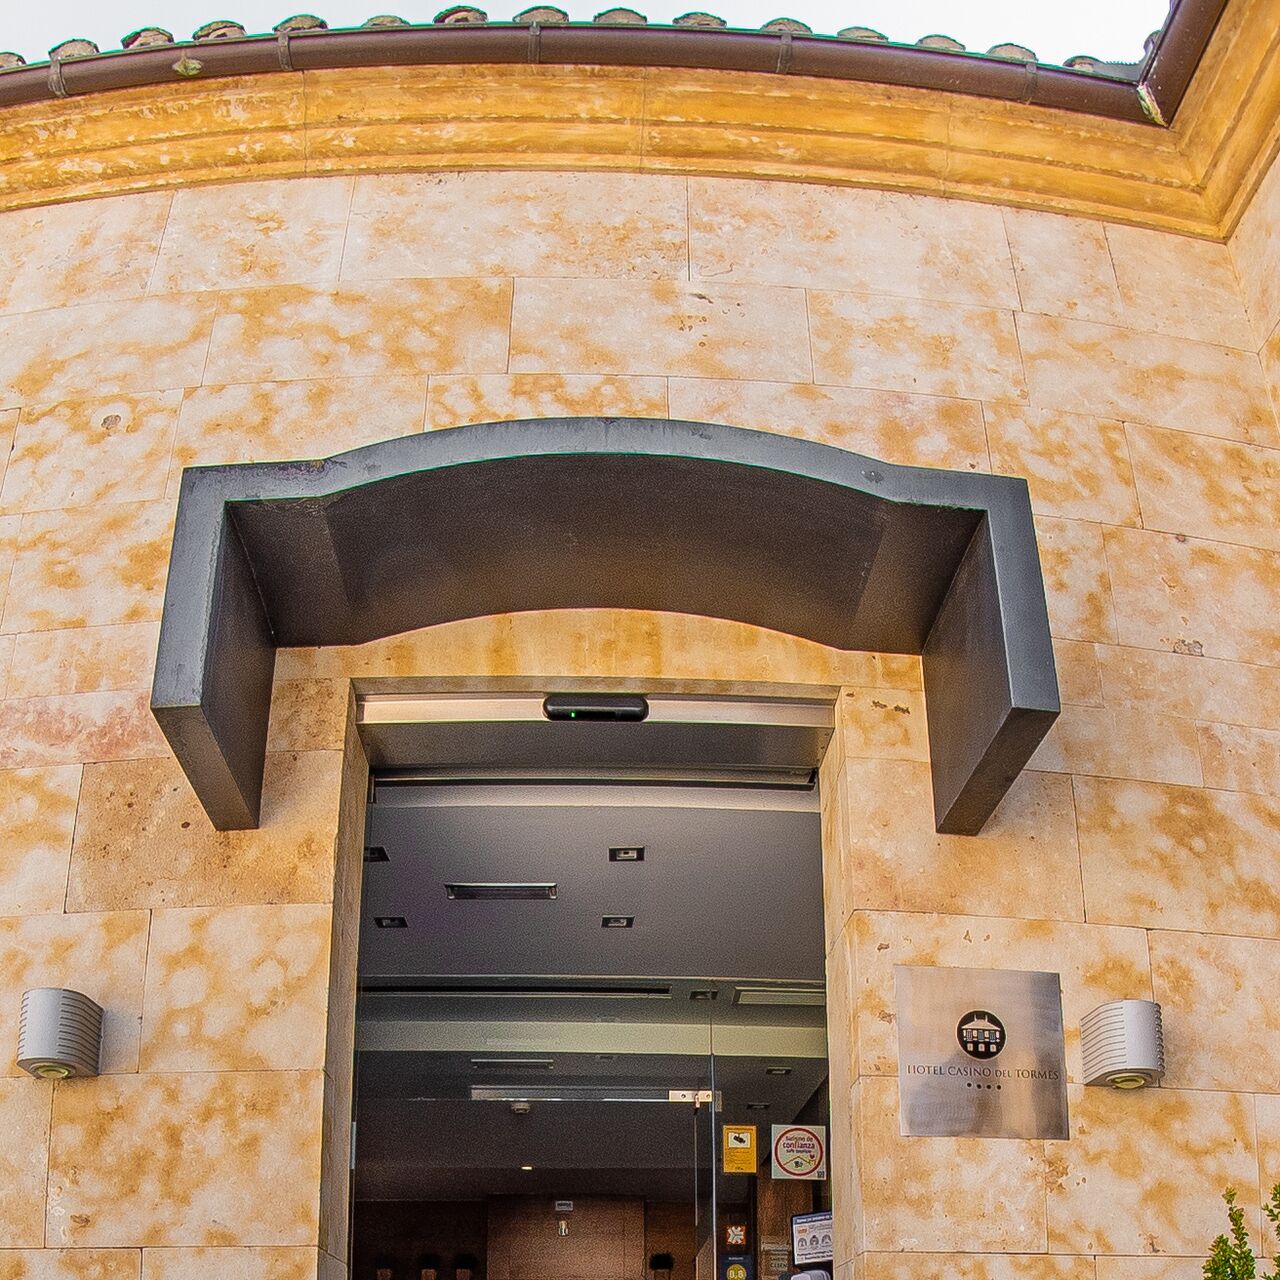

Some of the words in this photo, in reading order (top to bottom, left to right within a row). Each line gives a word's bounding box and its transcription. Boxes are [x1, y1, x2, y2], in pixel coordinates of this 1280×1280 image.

[907, 1064, 946, 1076] HOTEL
[947, 1065, 992, 1078] CASINO
[994, 1069, 1012, 1078] DEL
[1015, 1068, 1060, 1081] TORMES
